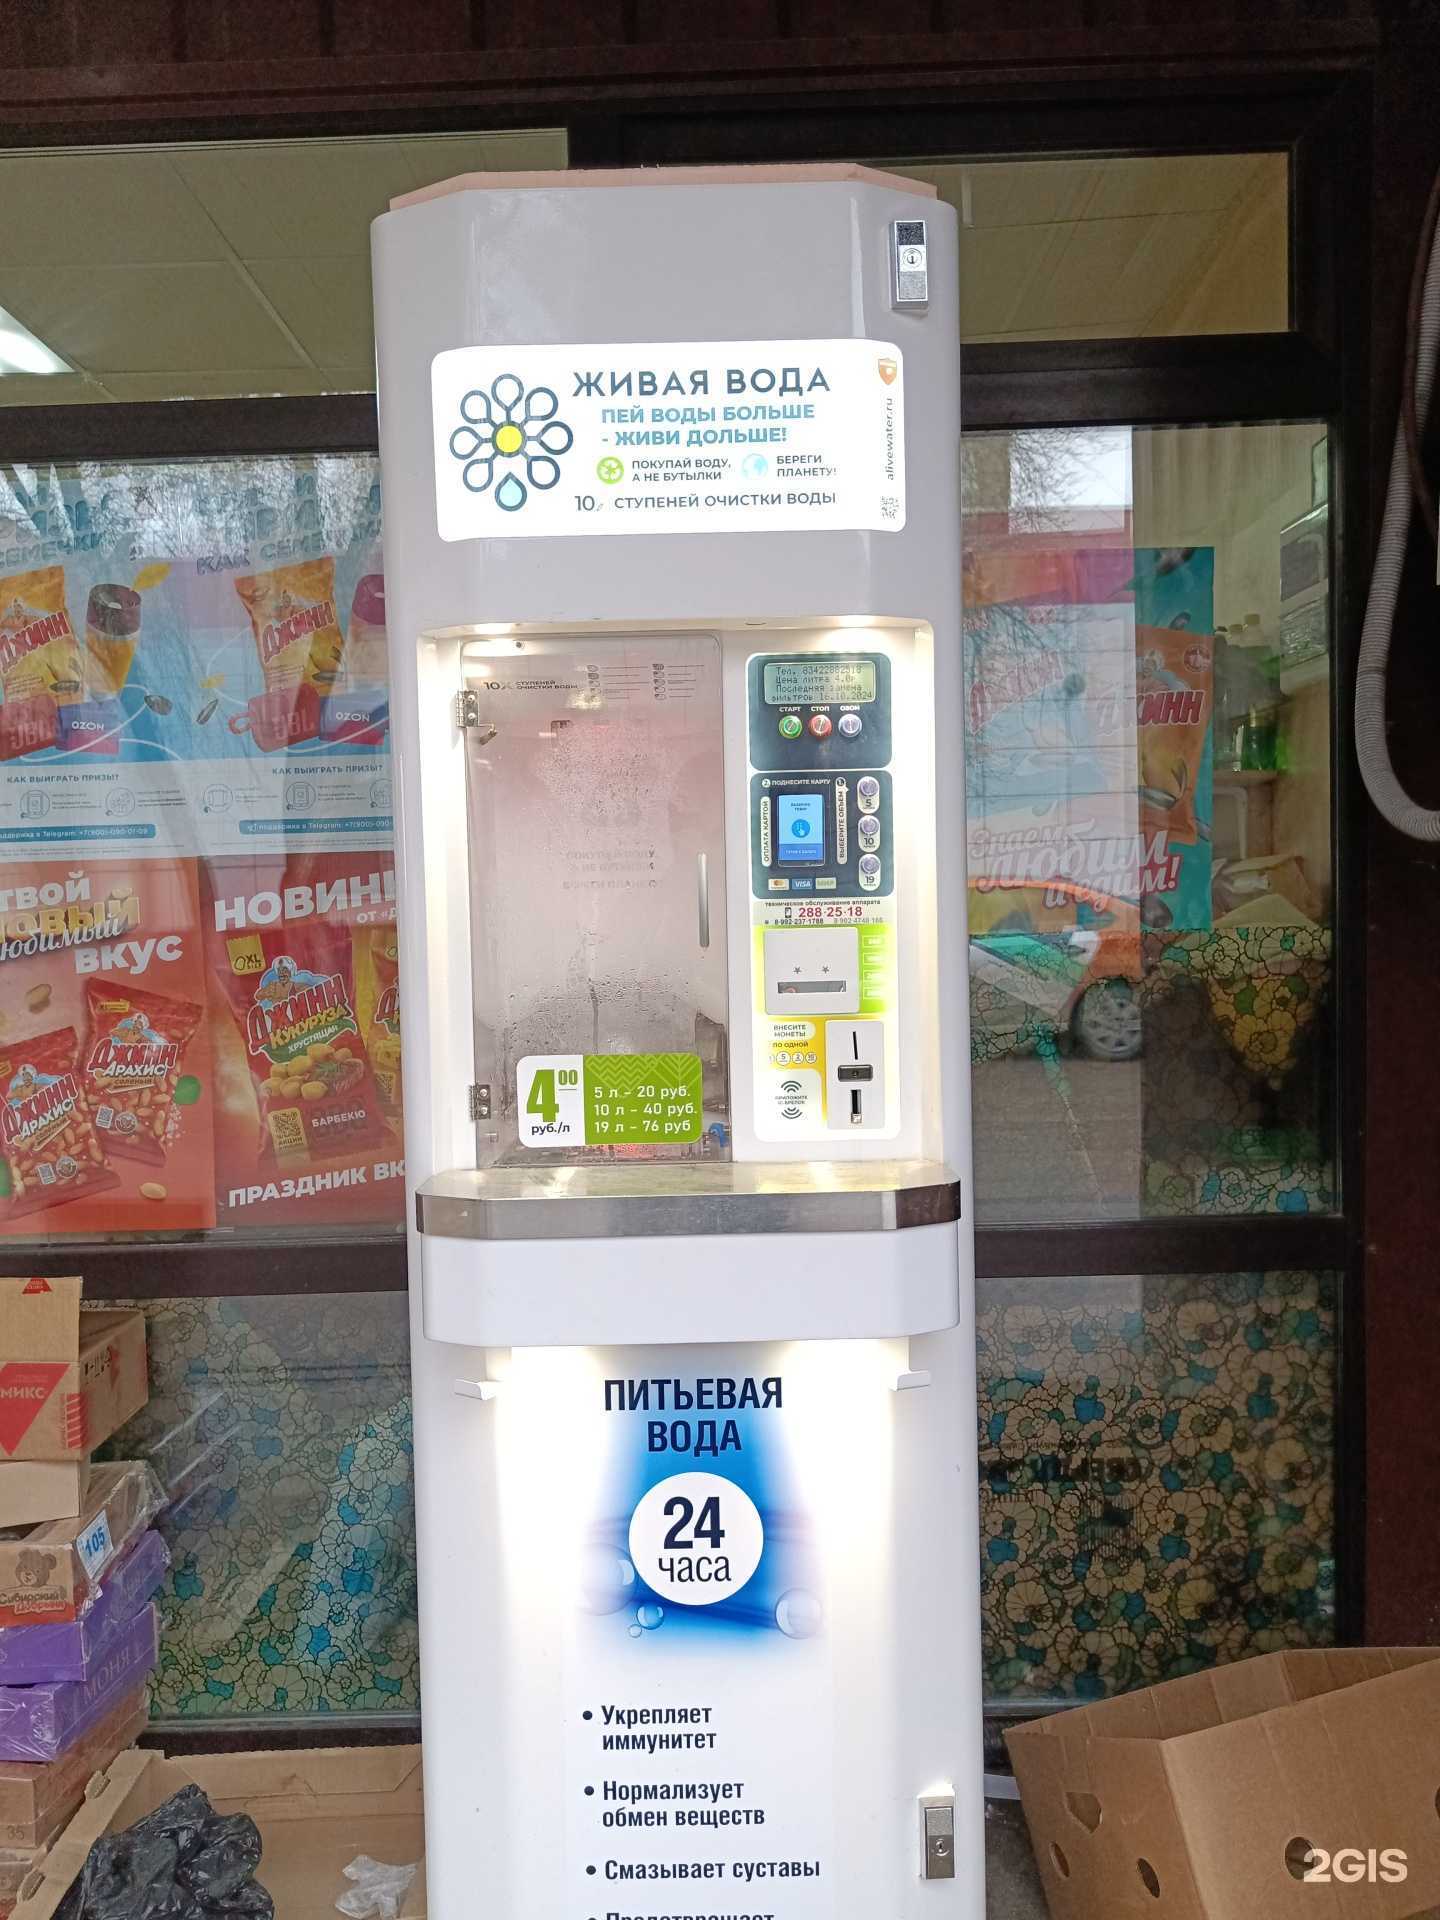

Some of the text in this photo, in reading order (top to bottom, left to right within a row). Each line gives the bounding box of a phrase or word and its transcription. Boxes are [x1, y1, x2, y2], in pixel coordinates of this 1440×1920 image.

[572, 367, 831, 397] ЖИВАЯ ВОДА
[601, 403, 815, 425] ПЕЙ ВОДЫ БОЛЬШЕ
[614, 429, 681, 447] ЖИВИ
[686, 426, 787, 447] ДОЛЬШЕ!
[885, 398, 894, 480] alivewater.ru
[631, 456, 732, 471] ПОКУПАЙ ВОДУ,
[776, 454, 823, 466] БЕРЕГИ
[632, 470, 722, 482] А НЕ БУТЫЛКИ
[776, 466, 837, 479] ПЛАНЕТУ!
[614, 492, 699, 510] СТУПЕНЕЙ
[704, 494, 782, 508] ОЧИСТКИ
[787, 491, 836, 506] ВОДЫ
[775, 666, 797, 676] Тел.
[775, 676, 798, 684] Цена
[803, 675, 830, 683] литра
[776, 684, 825, 693] Последняя
[71, 719, 105, 732] OZON
[335, 710, 372, 723] OZON
[7, 773, 120, 784] КАК ВЫИГРАТЬ ПРИЗЫ?
[272, 763, 383, 775] КАК ВЫИГРАТЬ ПРИЗЫ?
[865, 798, 872, 807] 5
[863, 837, 875, 846] 10
[795, 880, 811, 888] VISA
[864, 875, 875, 884] 19
[852, 899, 881, 907] аппарата
[249, 973, 353, 1056] ДЖИНН
[270, 1001, 351, 1048] КУКУРУЗА
[86, 1037, 179, 1072] ДЖИНН
[102, 1062, 168, 1077] АРАХИС
[594, 1088, 603, 1098] 5
[608, 1089, 619, 1098] л
[636, 1085, 655, 1097] 20
[660, 1086, 691, 1101] руб.
[1, 1072, 79, 1145] ДЖИНН
[594, 1105, 610, 1116] 10
[615, 1106, 625, 1115] л
[643, 1103, 662, 1115] 40
[667, 1103, 697, 1118] руб.
[20, 1099, 74, 1140] АРАХИС
[311, 1109, 366, 1128] БАРБЕКЮ
[594, 1121, 609, 1134] 19
[614, 1123, 624, 1133] л
[643, 1120, 659, 1132] 76
[664, 1119, 691, 1135] руб
[531, 1121, 571, 1136] руб./л
[228, 1165, 367, 1208] ПРАЗДНИК
[604, 1376, 783, 1411] ПИТЬЕВАЯ
[647, 1419, 743, 1458] ВОДА
[663, 1496, 726, 1550] 24
[85, 1526, 106, 1558] 105
[657, 1555, 732, 1583] часа
[601, 1704, 713, 1729] Укрепляет
[602, 1732, 717, 1755] иммунитет
[603, 1780, 745, 1805] Нормализует
[602, 1806, 766, 1829] обмен веществ
[604, 1859, 821, 1882] Смазывает суставы
